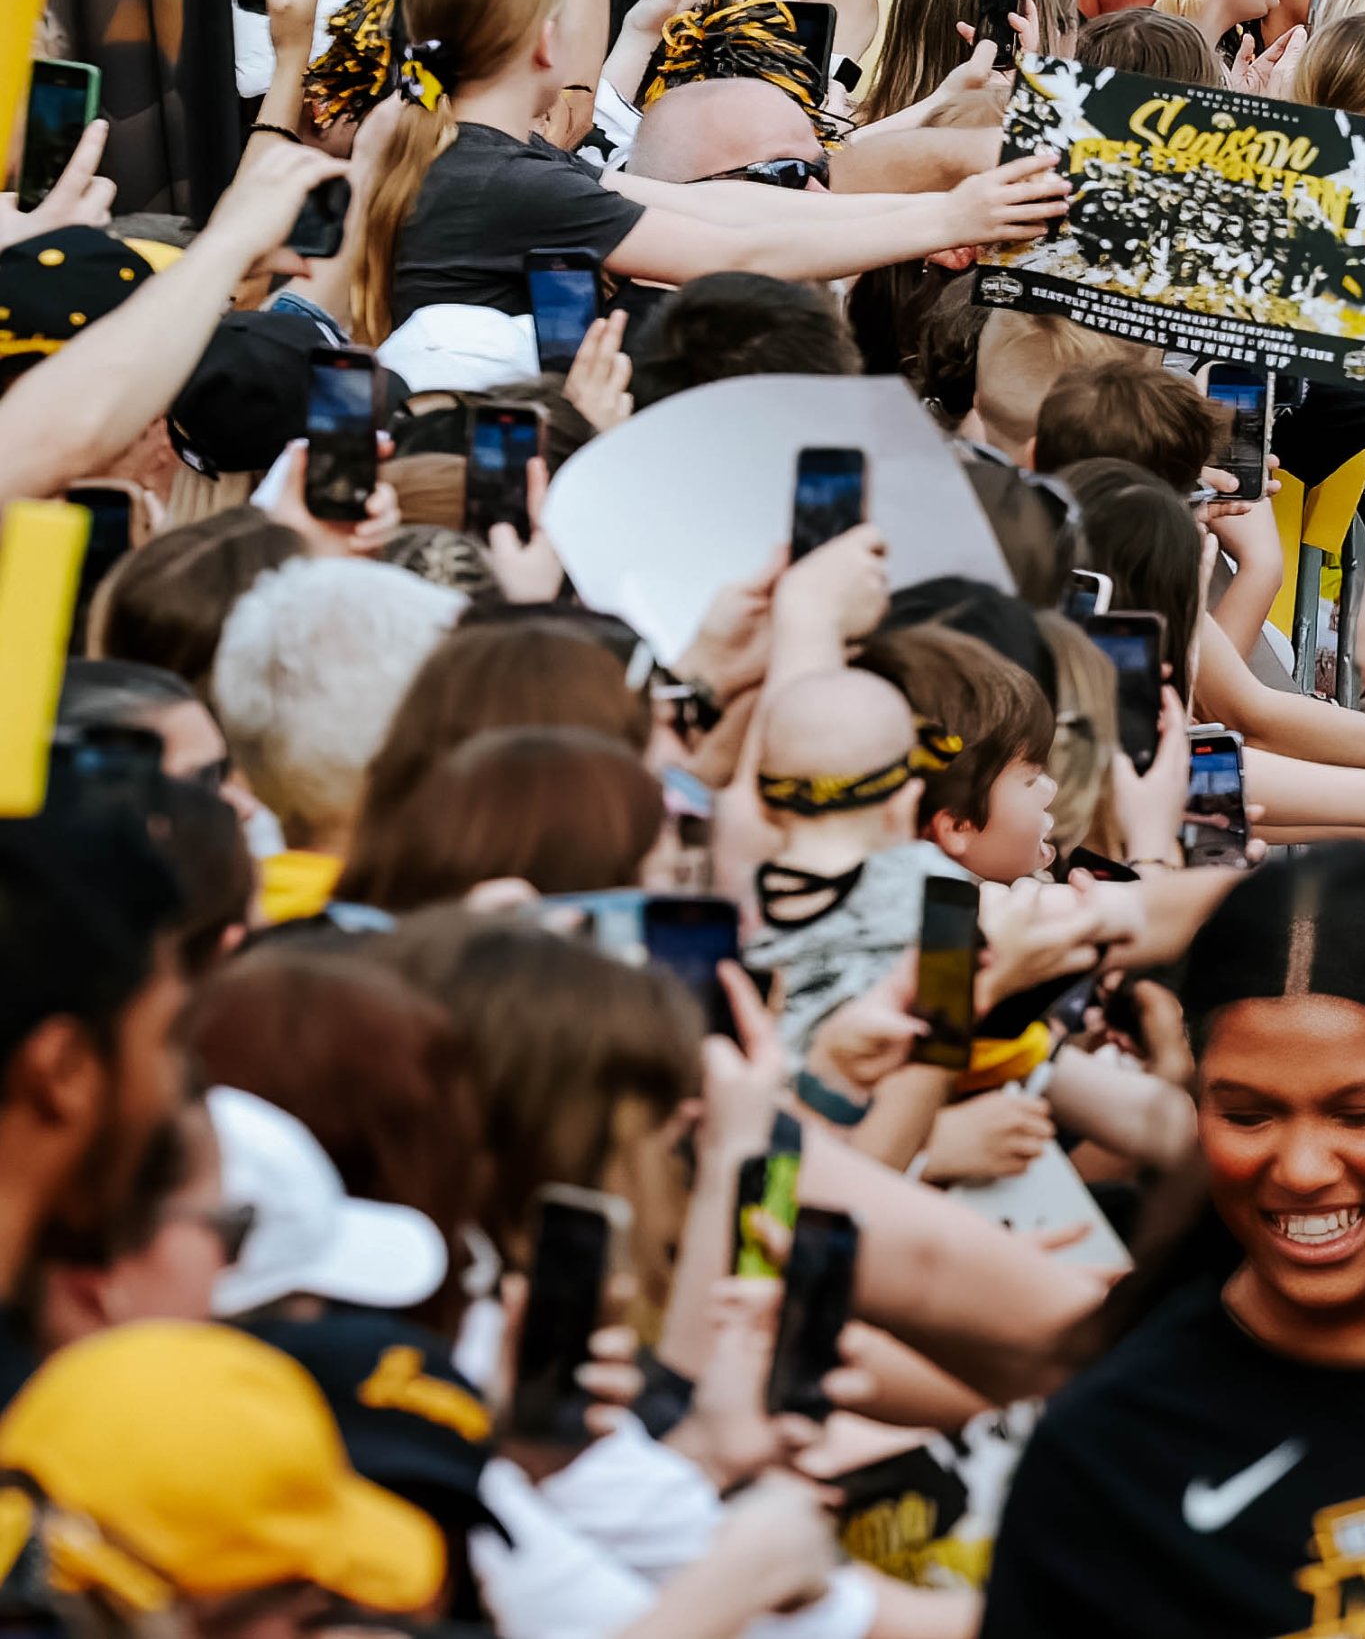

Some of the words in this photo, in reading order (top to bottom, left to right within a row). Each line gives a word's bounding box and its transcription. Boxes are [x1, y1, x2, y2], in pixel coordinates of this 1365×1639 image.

[1128, 96, 1321, 170] Season
[1070, 309, 1169, 345] NATIONAL
[1176, 335, 1257, 363] RUNNER
[1265, 353, 1292, 369] UP
